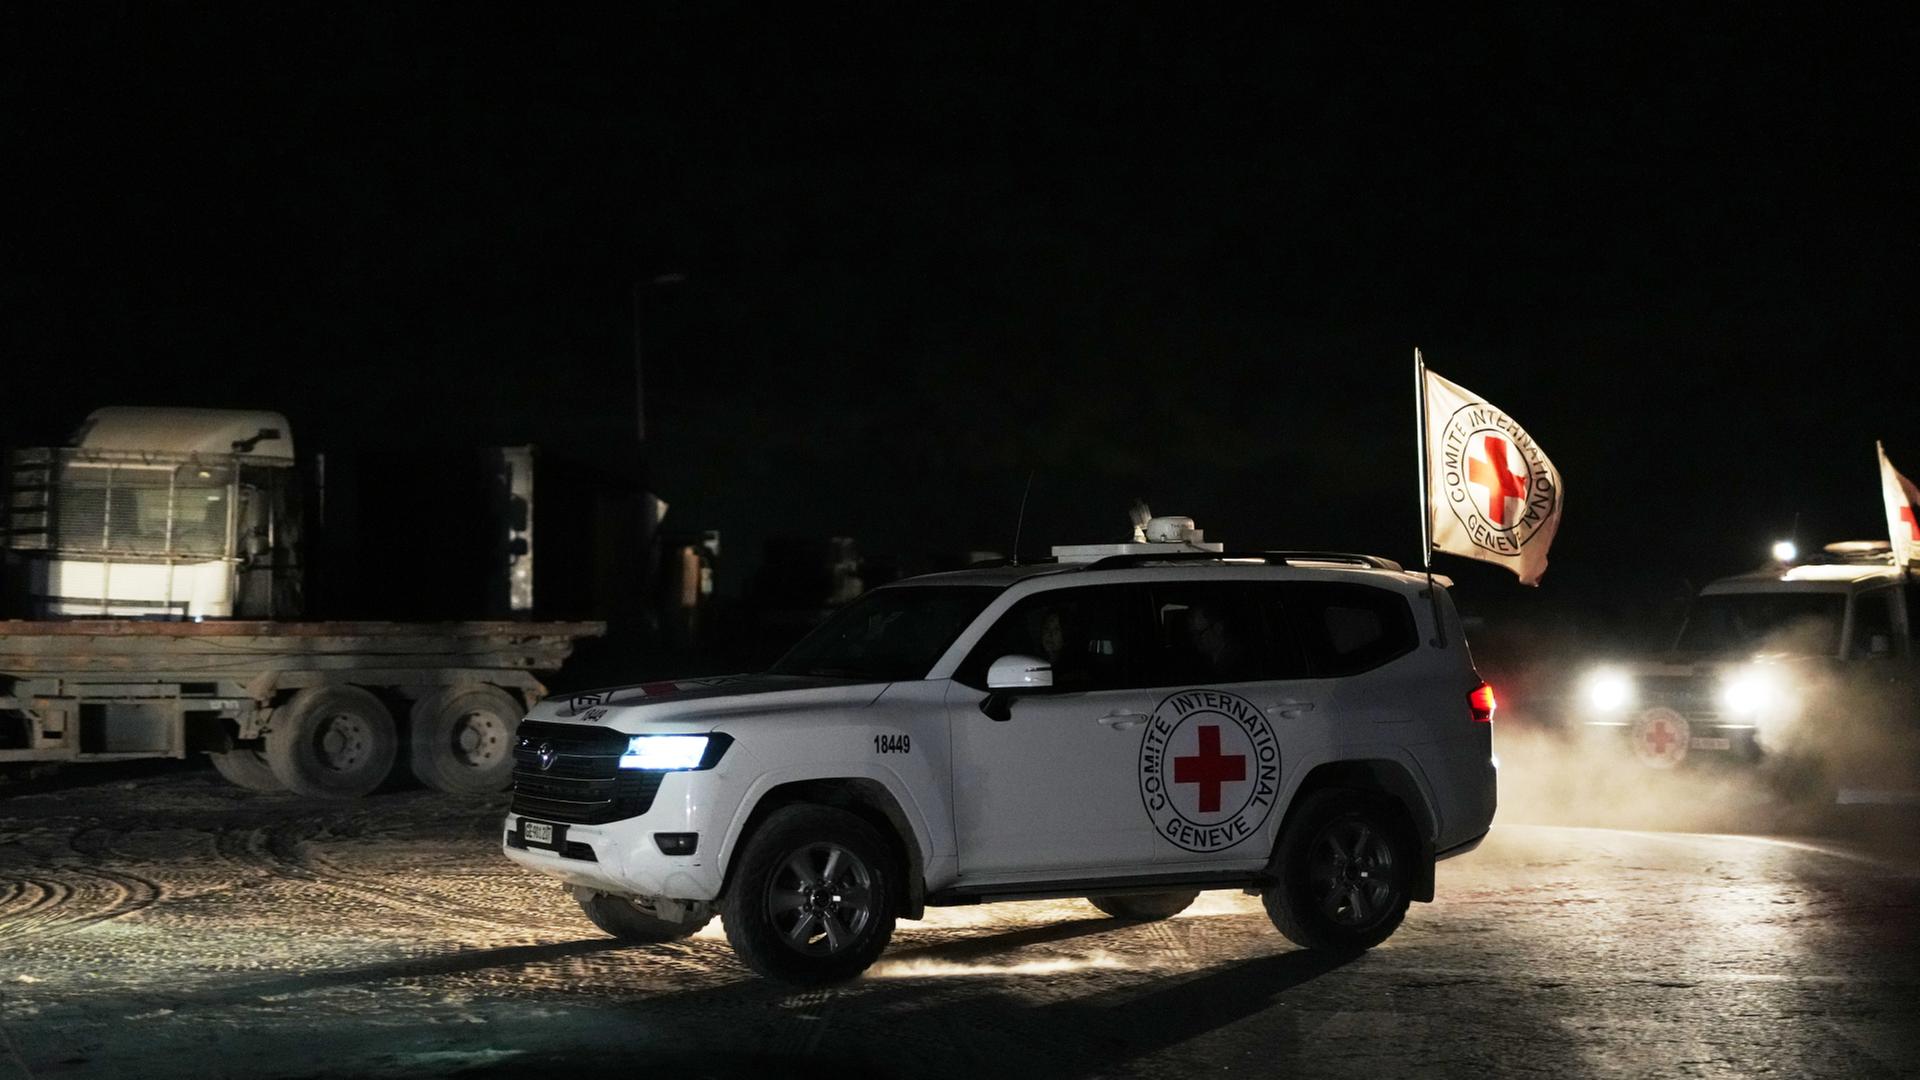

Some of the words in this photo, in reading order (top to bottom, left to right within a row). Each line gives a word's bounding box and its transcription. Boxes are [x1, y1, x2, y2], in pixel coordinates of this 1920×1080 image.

[1445, 422, 1467, 503] COMITE
[1468, 514, 1521, 551] GENEV
[874, 735, 910, 753] 18449
[1144, 716, 1171, 811] COMITE
[1171, 693, 1276, 807] INTERNATIONAL
[1167, 816, 1250, 847] GENEVE
